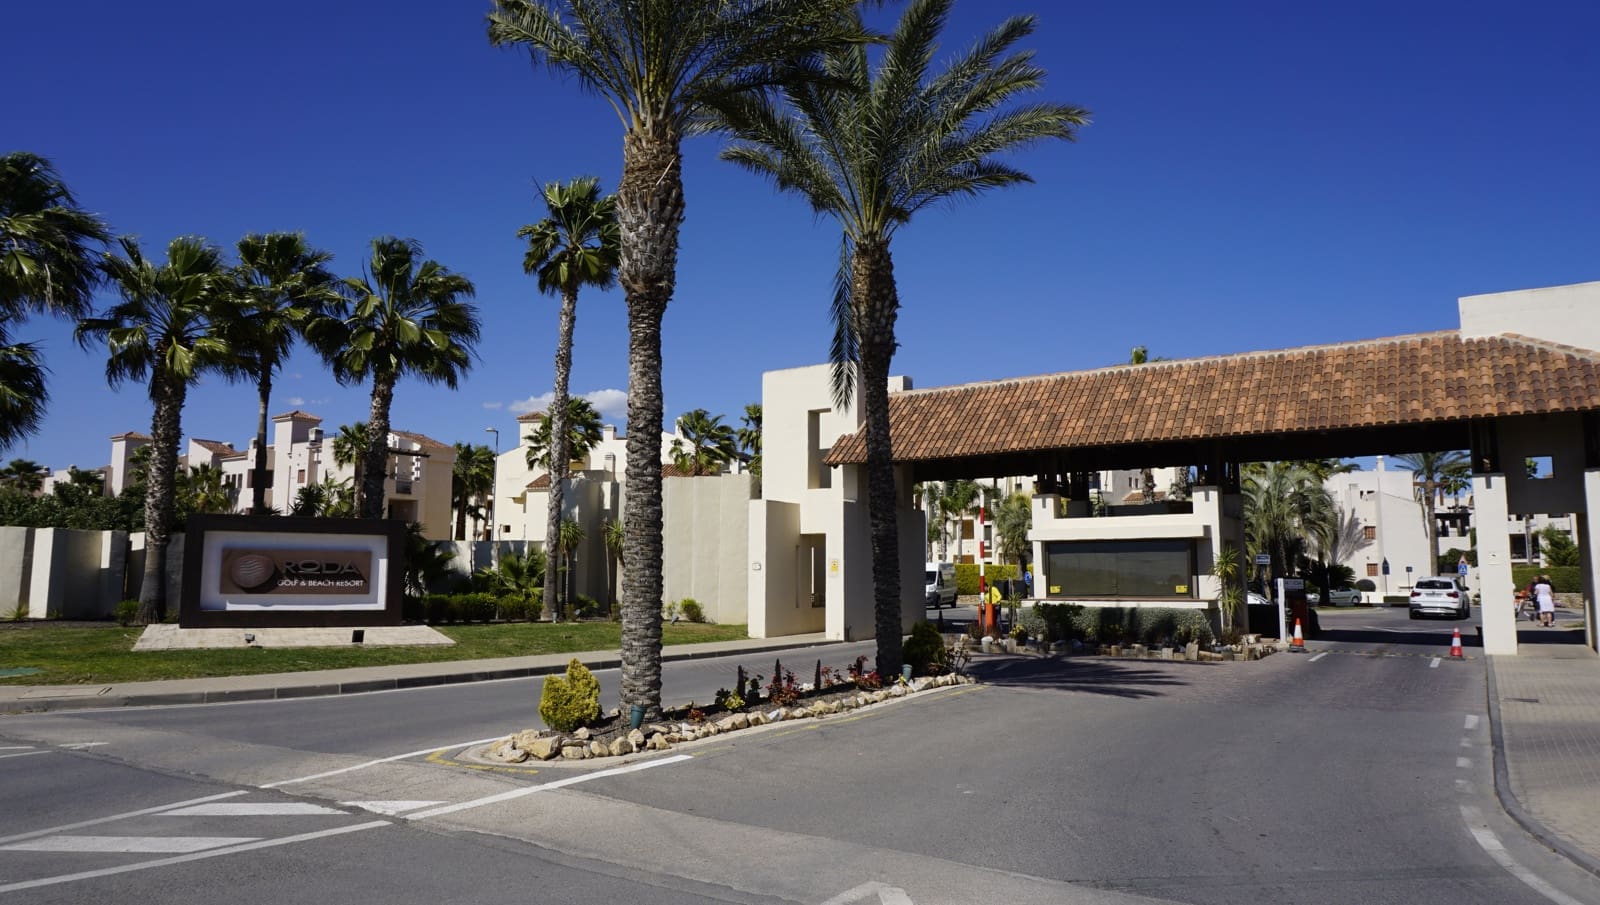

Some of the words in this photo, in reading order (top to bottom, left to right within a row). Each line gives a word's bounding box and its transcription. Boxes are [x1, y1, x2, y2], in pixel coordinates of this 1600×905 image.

[282, 560, 360, 574] RODA
[278, 579, 299, 587] GOLF
[308, 579, 334, 587] BEACH
